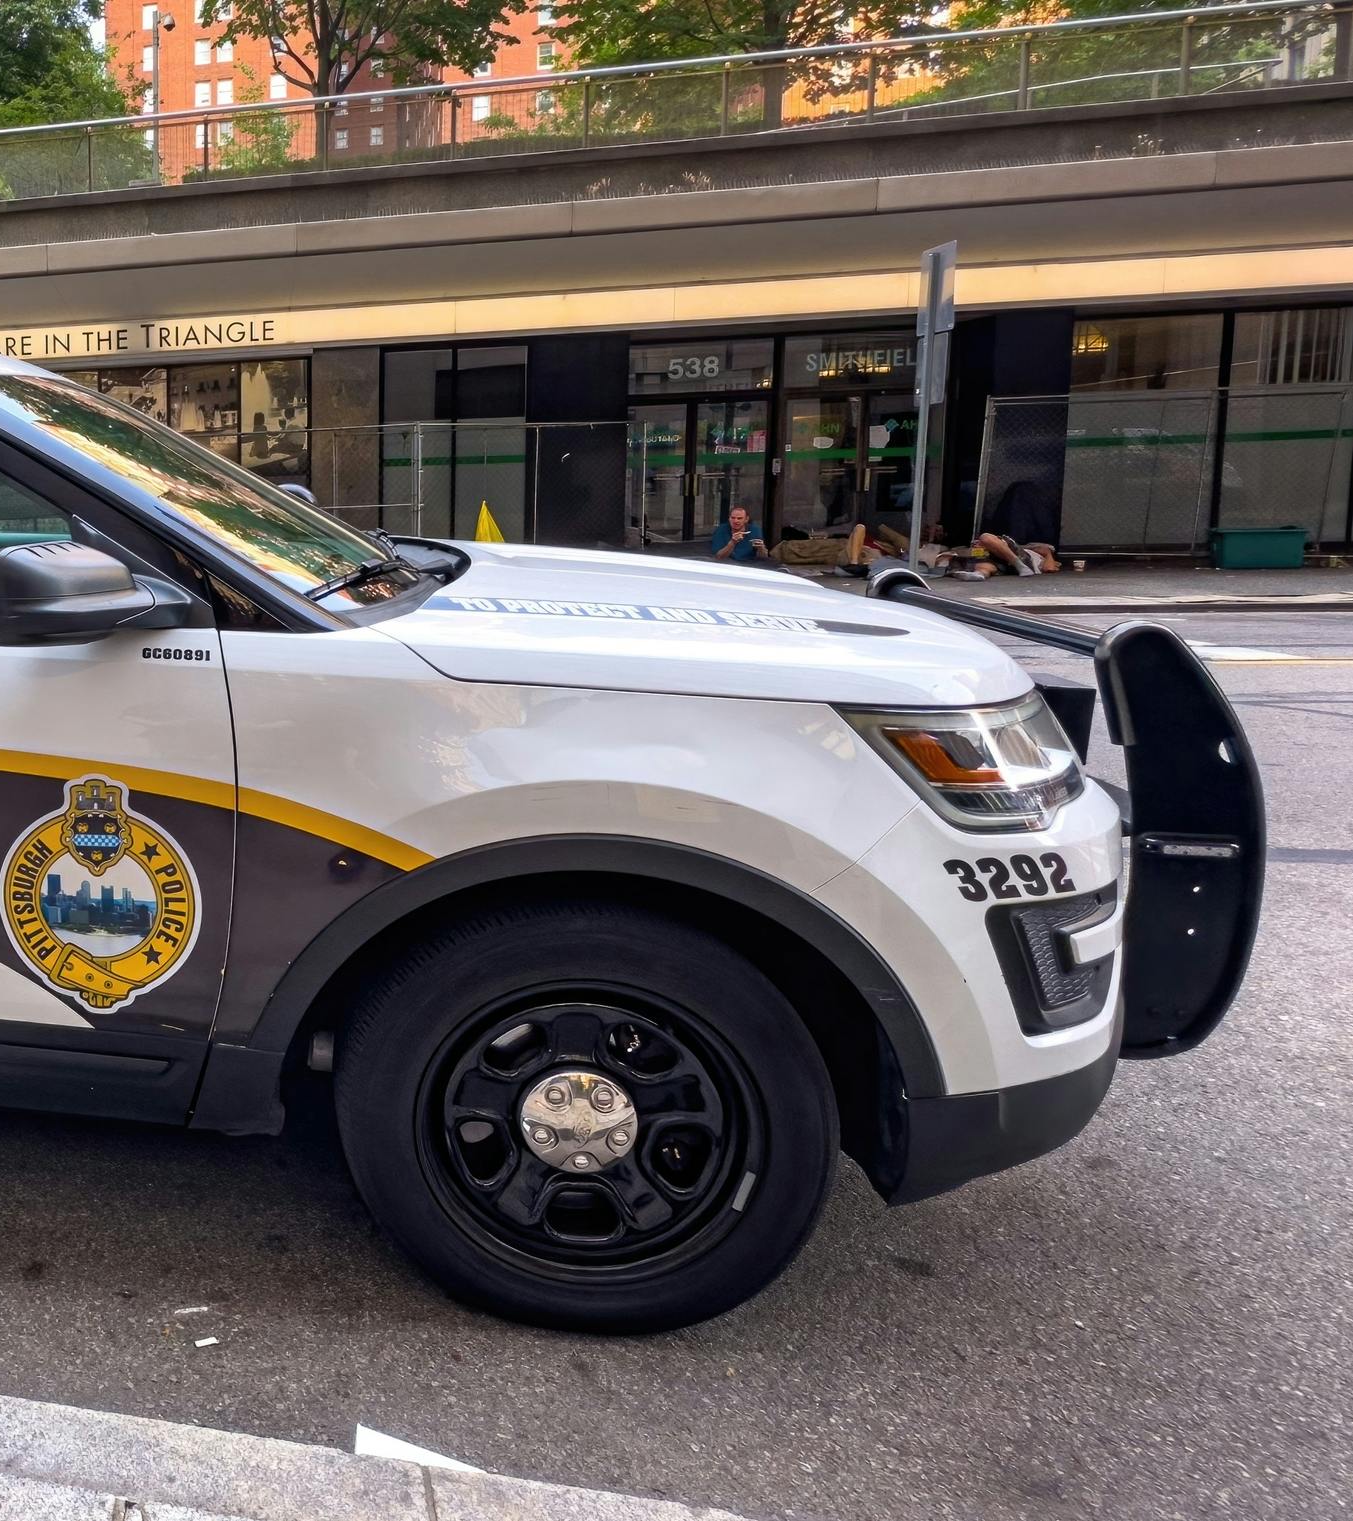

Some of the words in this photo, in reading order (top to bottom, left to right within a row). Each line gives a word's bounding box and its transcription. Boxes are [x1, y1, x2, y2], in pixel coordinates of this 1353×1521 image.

[45, 333, 71, 355] IN
[82, 329, 128, 352] THE
[140, 320, 274, 348] TRIANGLE
[667, 356, 720, 380] 538
[806, 349, 918, 372] SMITHFIEL
[448, 597, 497, 612] TO
[496, 598, 643, 619] PROTECT
[646, 605, 718, 624] AND
[716, 611, 826, 633] SERVE
[142, 647, 211, 661] GC60891
[943, 851, 1077, 902] 3292
[11, 838, 57, 961] PITTSBURGH
[154, 863, 187, 948] POLICE
